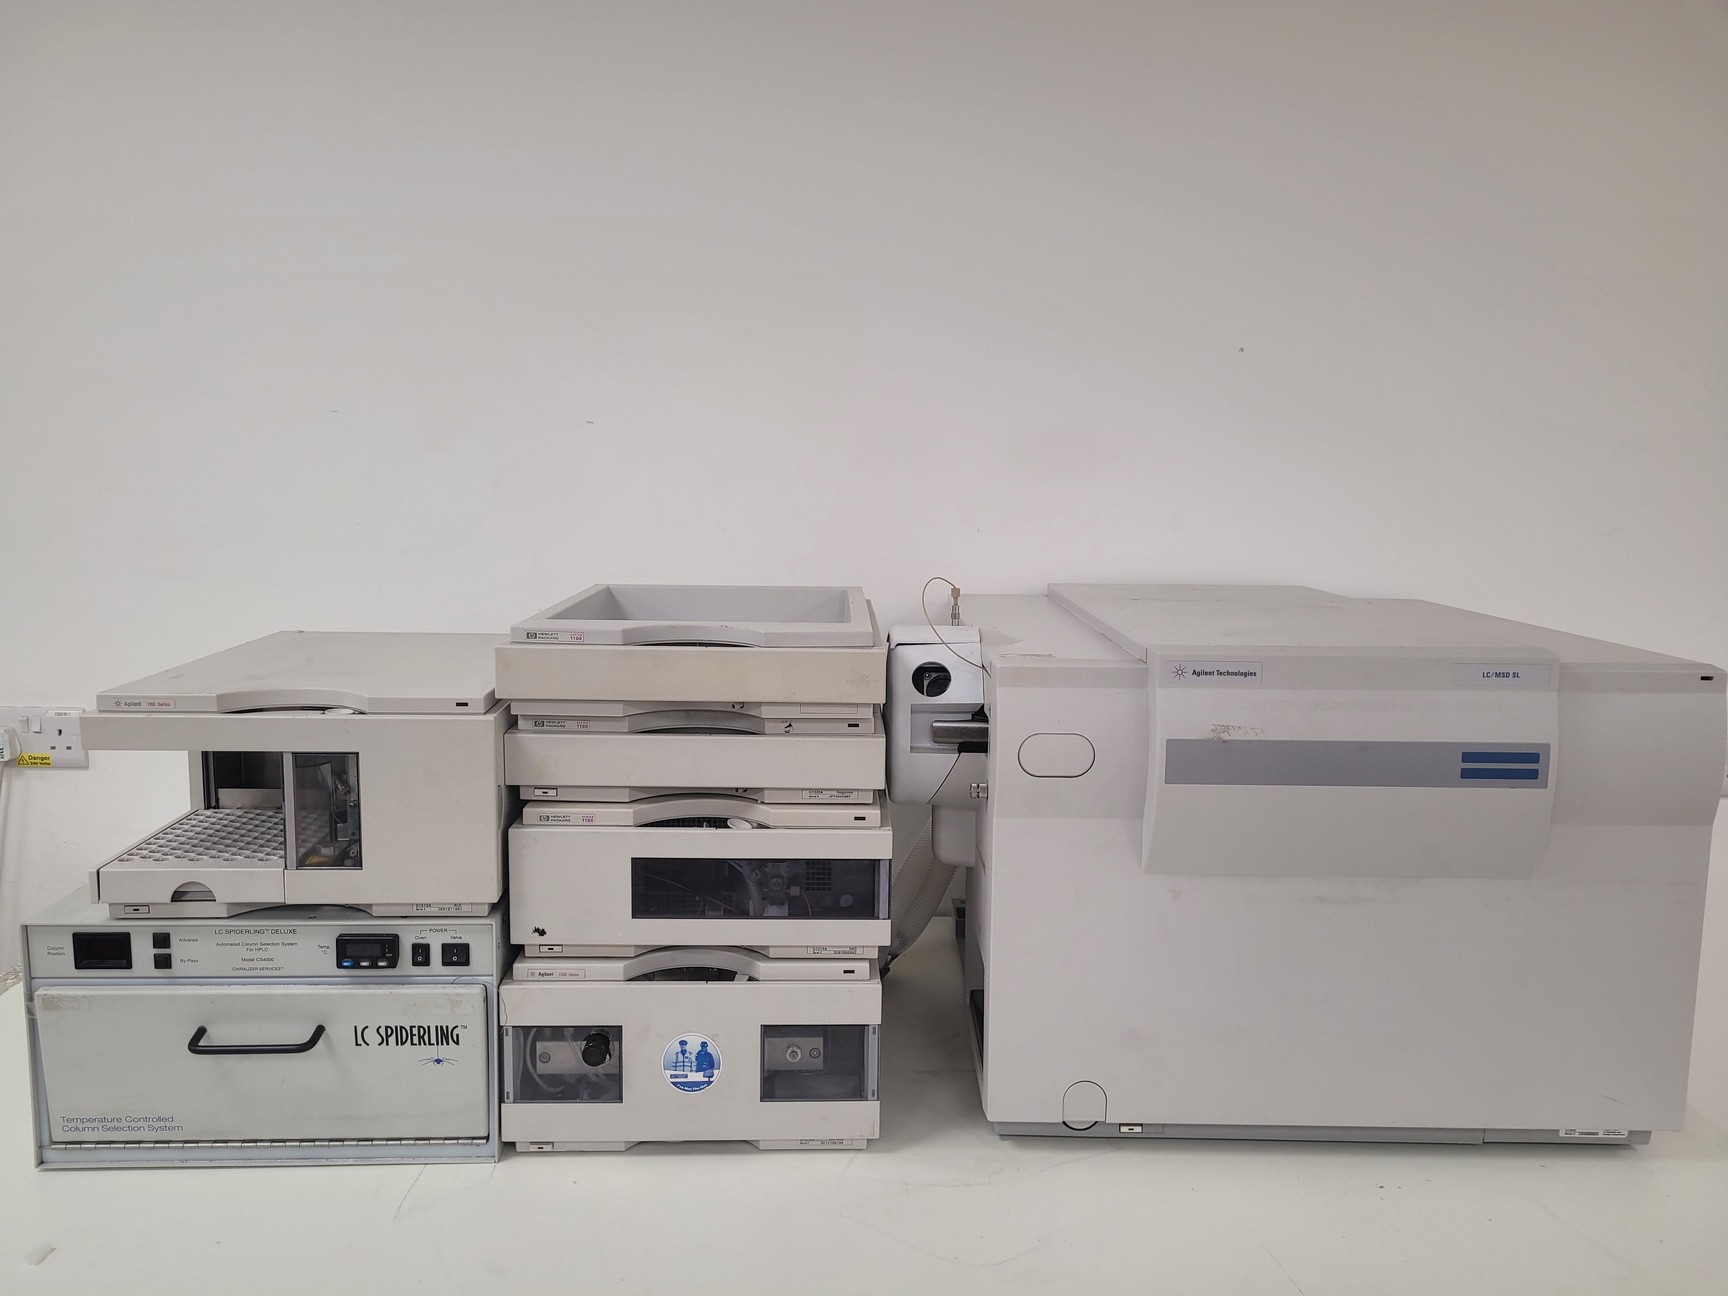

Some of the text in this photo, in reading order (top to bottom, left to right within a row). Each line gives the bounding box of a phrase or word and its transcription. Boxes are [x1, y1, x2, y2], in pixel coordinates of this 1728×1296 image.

[1192, 669, 1257, 678] Agilent Technologies
[354, 1025, 370, 1046] LC
[61, 1115, 174, 1124] Temperature Controlled
[101, 1124, 145, 1132] Selection
[147, 1124, 184, 1133] System
